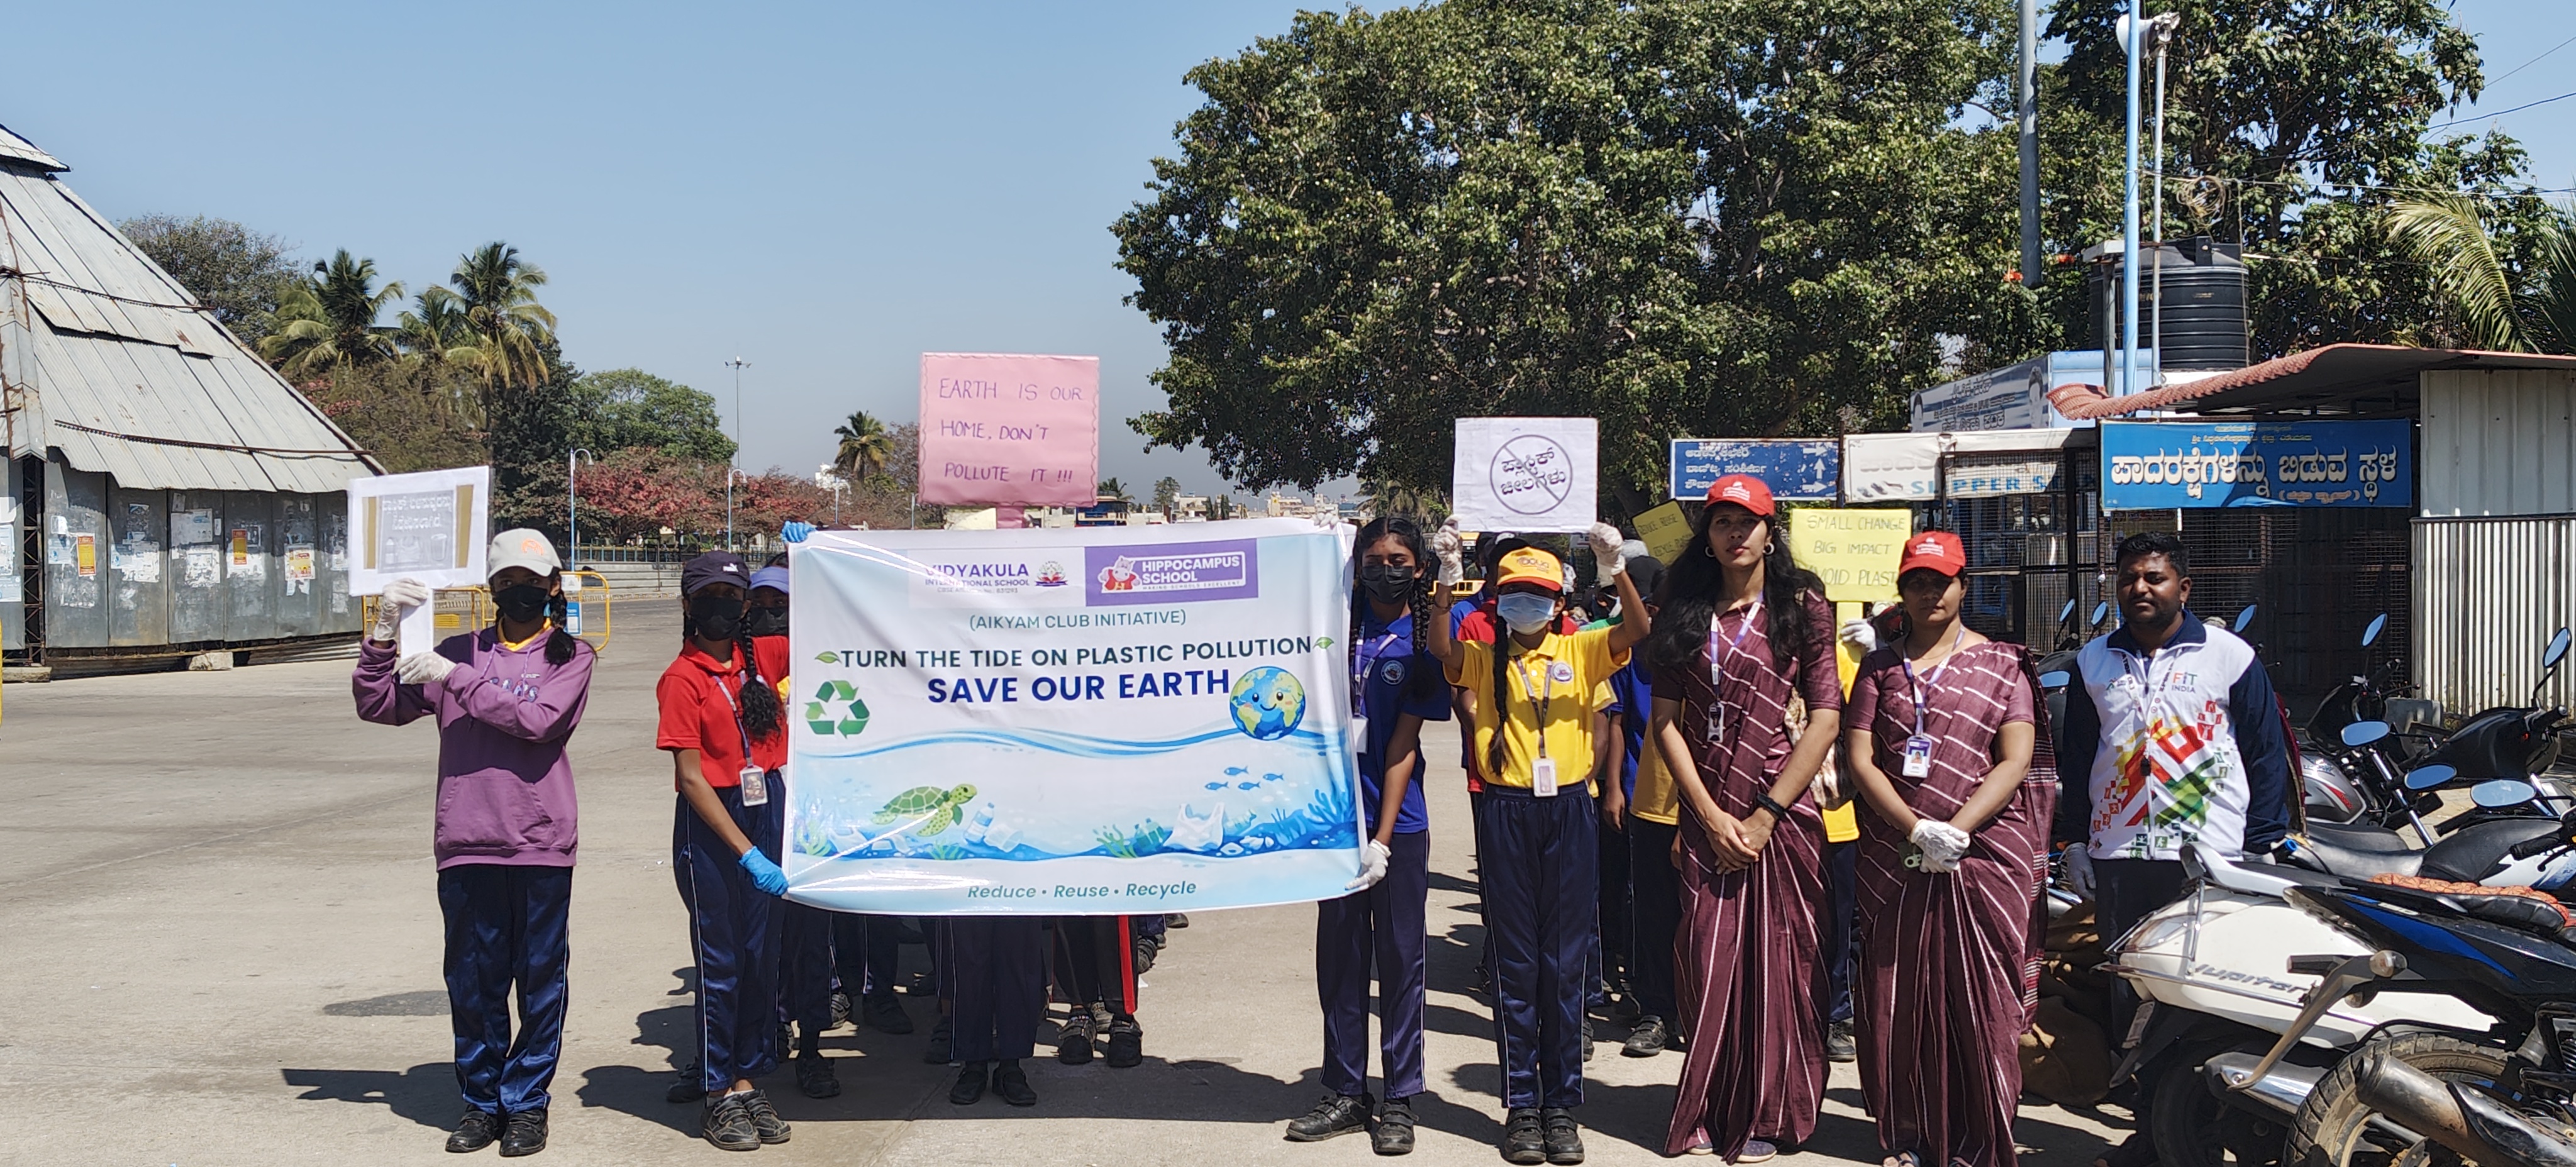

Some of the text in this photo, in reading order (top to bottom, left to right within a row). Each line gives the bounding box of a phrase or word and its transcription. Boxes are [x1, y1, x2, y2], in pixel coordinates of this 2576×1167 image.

[940, 378, 1083, 401] EARTH IS OUR
[999, 424, 1049, 440] DON'T
[945, 462, 1010, 482] POLLUTE
[1031, 469, 1047, 482] IT
[2111, 445, 2397, 504] ಪಾದರಕ್ಷೆಗಳನ್ನು ಬಿಡುವ ಸ್ಥಳ
[1911, 476, 2021, 494] SLPPER
[1807, 515, 1905, 530] SMALL CHANGE
[1848, 543, 1892, 555] IMPACT
[925, 564, 1029, 577] VIDYAKULA
[1143, 556, 1240, 572] HIPPOCAMPUS
[925, 578, 1030, 587] INTENTIONAL SCHOOL
[1143, 571, 1197, 584] SCHOOL
[1813, 568, 1897, 586] VOID PLAST
[970, 609, 1186, 631] (AIKYAM CLUB INITIATIVE)
[841, 636, 1311, 668] TURN THE TIDE ON PLASTIC POLLUTION
[928, 669, 1230, 703] SAVE OUR EARTH
[2172, 685, 2196, 694] INDIA
[967, 881, 1196, 899] Reduce Reuse Recycle
